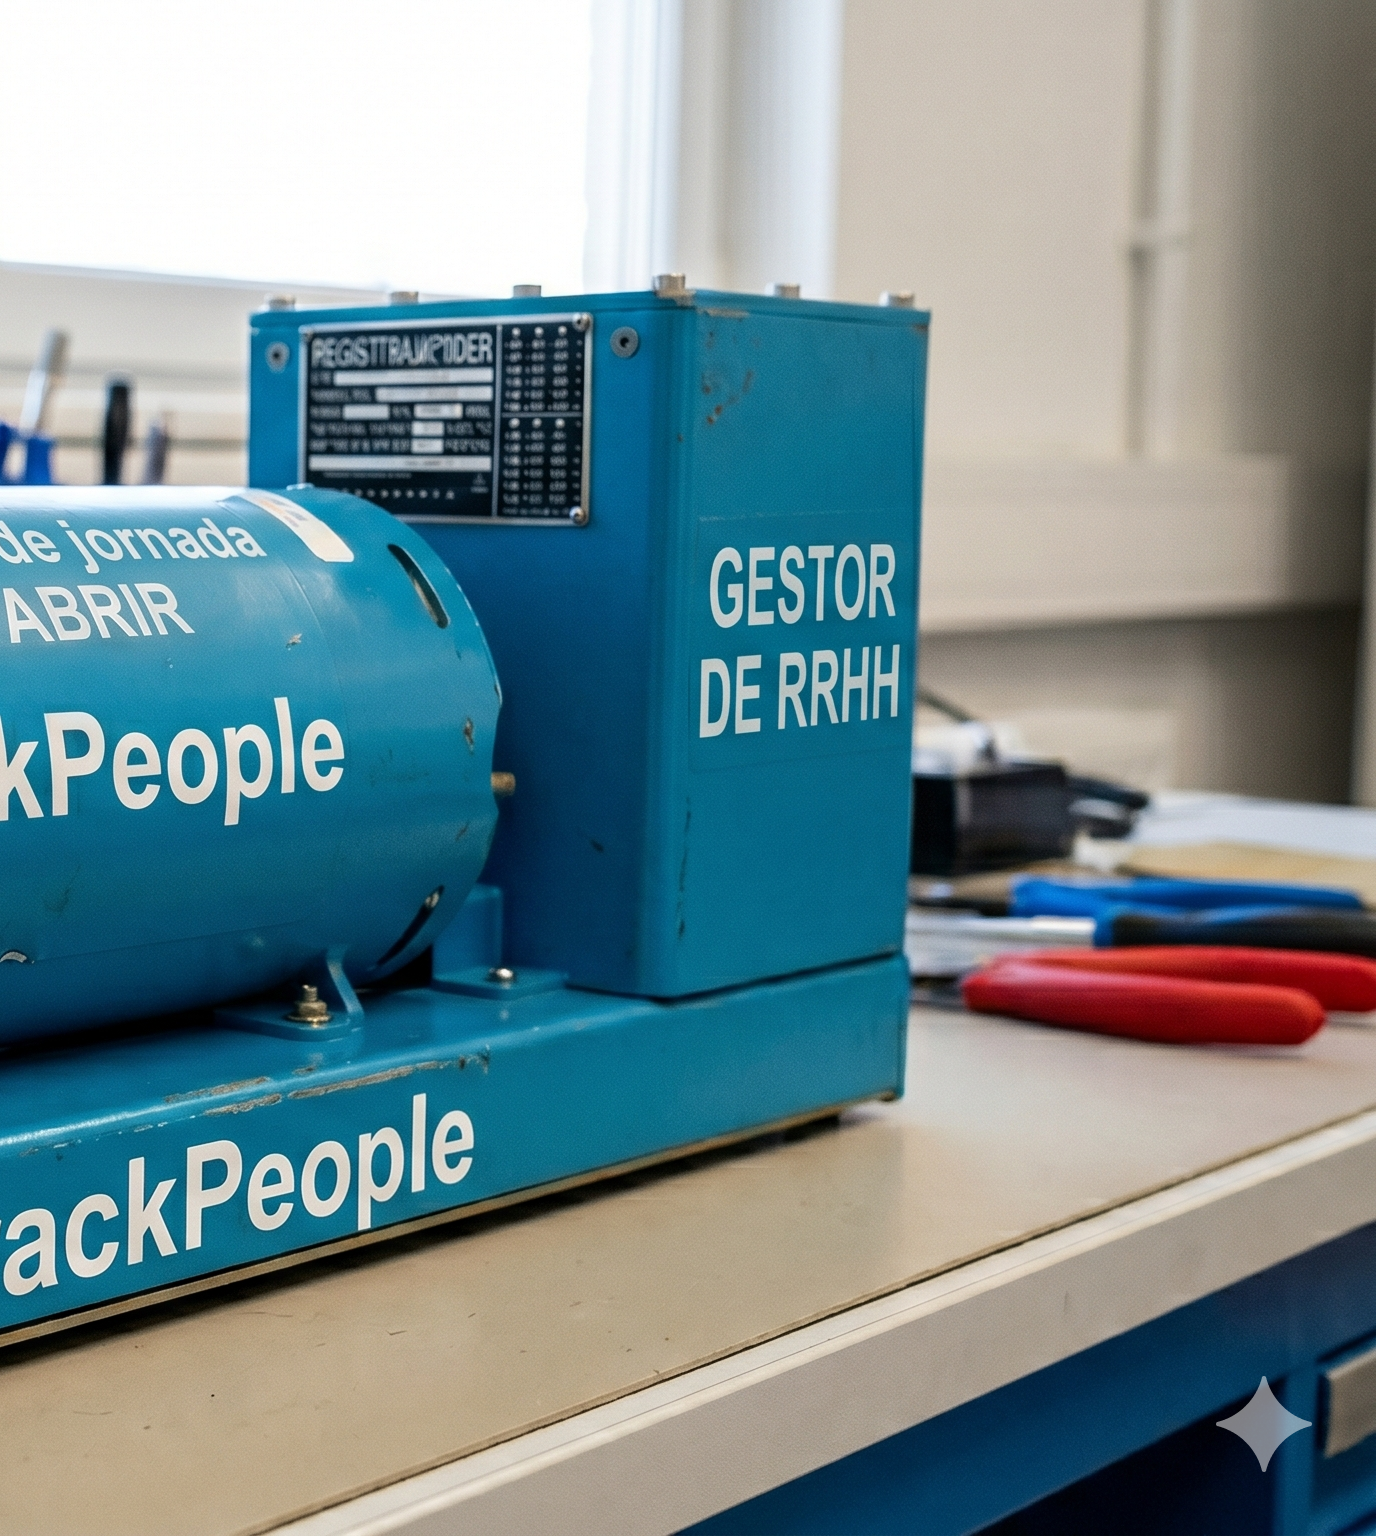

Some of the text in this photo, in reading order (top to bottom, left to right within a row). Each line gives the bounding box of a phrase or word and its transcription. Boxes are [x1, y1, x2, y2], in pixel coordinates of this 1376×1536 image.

[64, 517, 268, 575] jornada
[2, 582, 195, 645] ABRIR
[709, 543, 896, 629] GESTOR
[699, 644, 900, 738] DE RRHH
